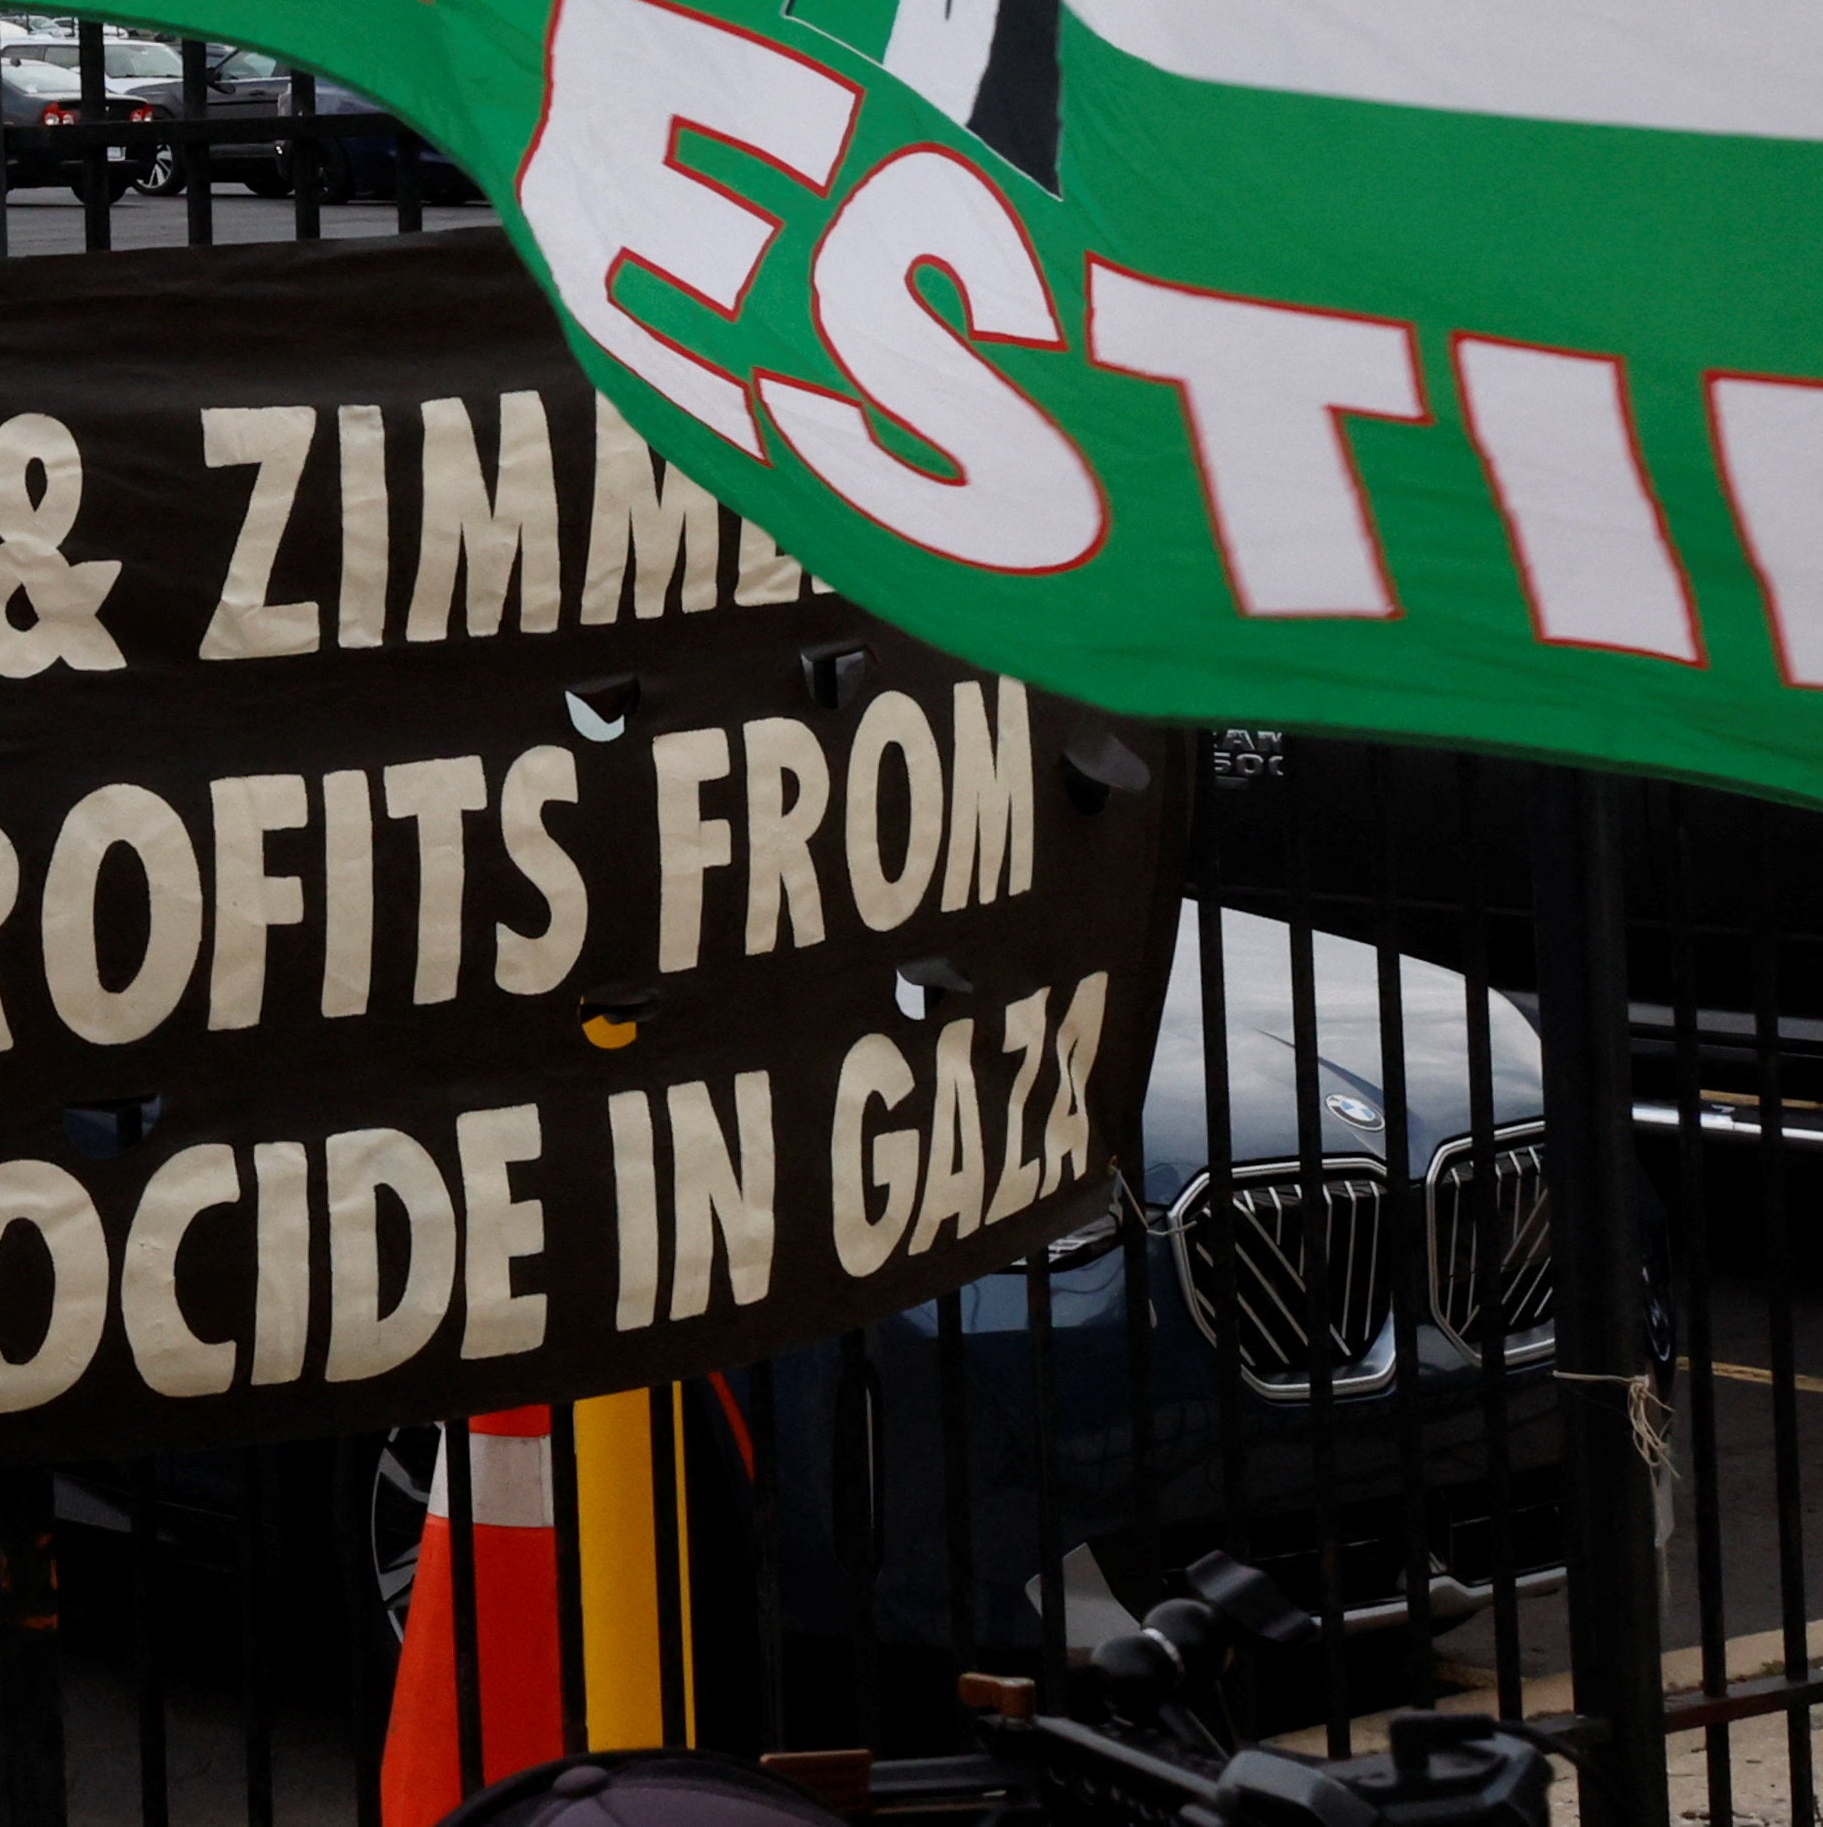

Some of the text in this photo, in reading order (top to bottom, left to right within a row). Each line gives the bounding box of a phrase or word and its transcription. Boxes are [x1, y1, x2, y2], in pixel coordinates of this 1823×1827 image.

[198, 389, 836, 663] ZIMM
[651, 679, 1037, 974] FROM
[608, 1069, 777, 1331] IN
[830, 970, 1110, 1279] GAZA
